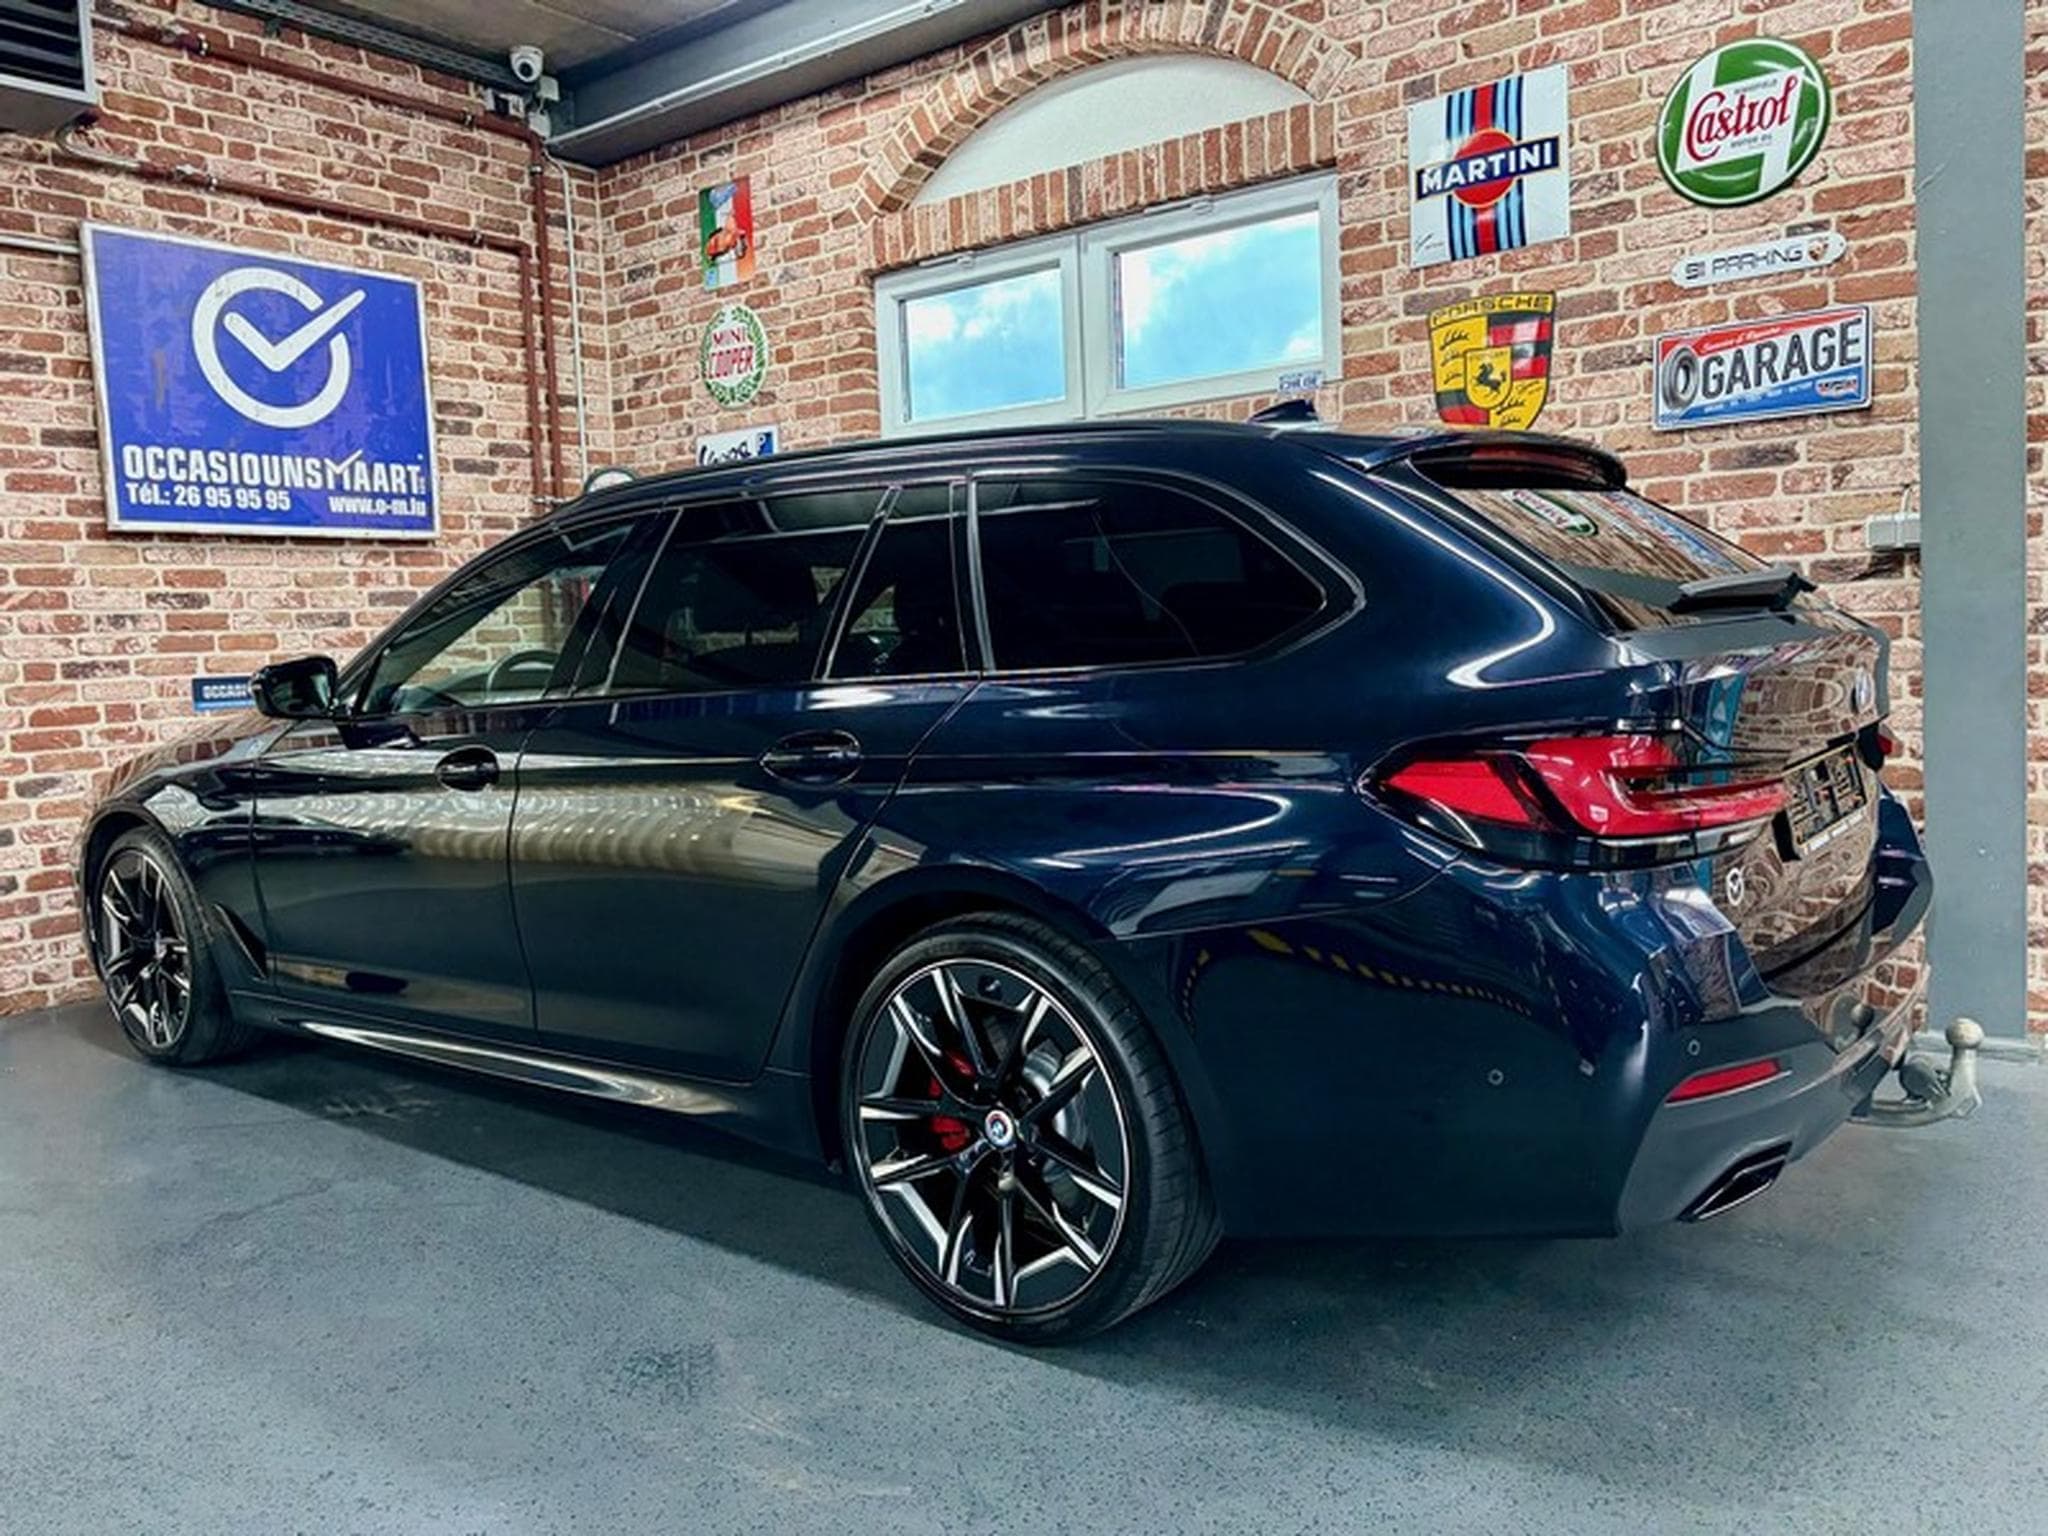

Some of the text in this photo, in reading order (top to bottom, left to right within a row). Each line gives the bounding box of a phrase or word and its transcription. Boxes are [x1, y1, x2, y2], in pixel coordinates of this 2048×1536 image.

[1686, 75, 1798, 161] Castrol
[1421, 141, 1552, 195] MARTINI
[1712, 244, 1804, 276] PARKING
[1433, 295, 1550, 325] PORSCHE
[713, 326, 747, 347] MINI
[708, 345, 754, 379] COOPER
[1701, 317, 1863, 399] GARAGE
[122, 445, 420, 495] OCCASIOUNSMAART
[174, 485, 201, 508] 26
[205, 486, 232, 509] 95
[235, 488, 261, 511] 95
[266, 490, 291, 512] 95
[203, 684, 248, 699] OCCASI
